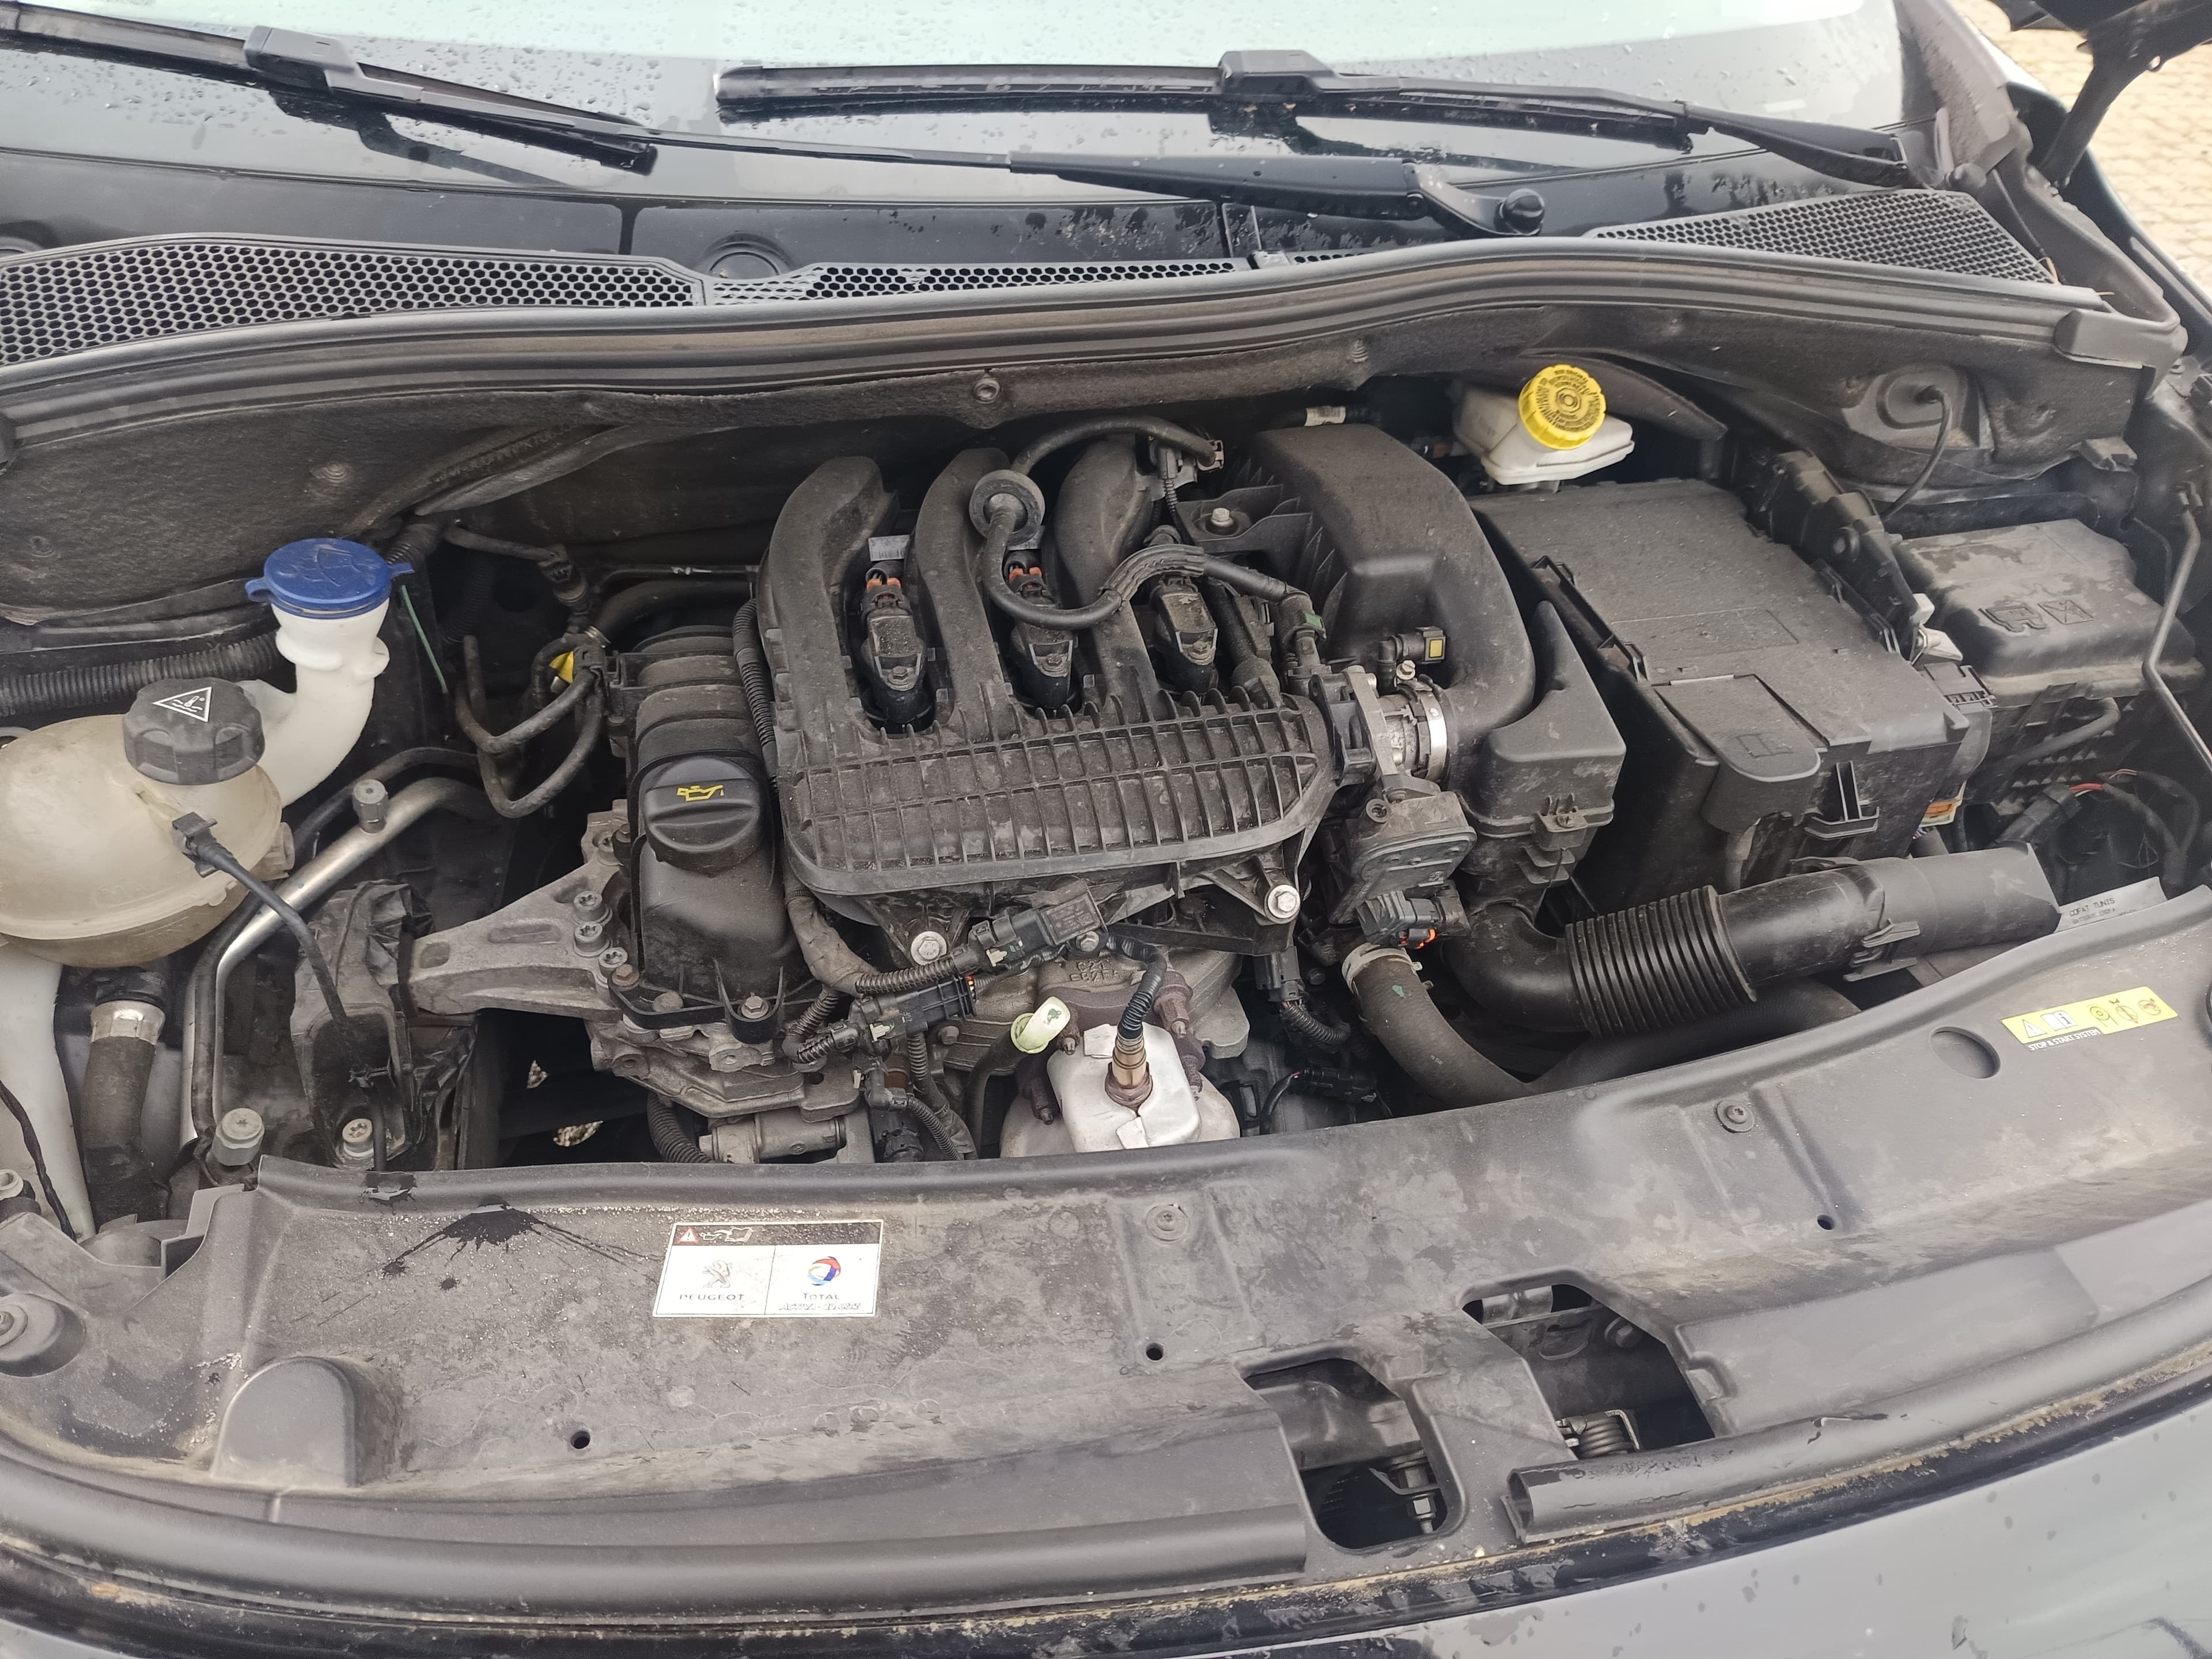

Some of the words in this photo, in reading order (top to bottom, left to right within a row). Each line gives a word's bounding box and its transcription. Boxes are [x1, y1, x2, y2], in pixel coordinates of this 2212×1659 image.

[2093, 897, 2116, 908] TUNIS
[2028, 1041, 2047, 1051] STOP
[2052, 1035, 2074, 1045] START
[2074, 1029, 2101, 1039] SYSTEM
